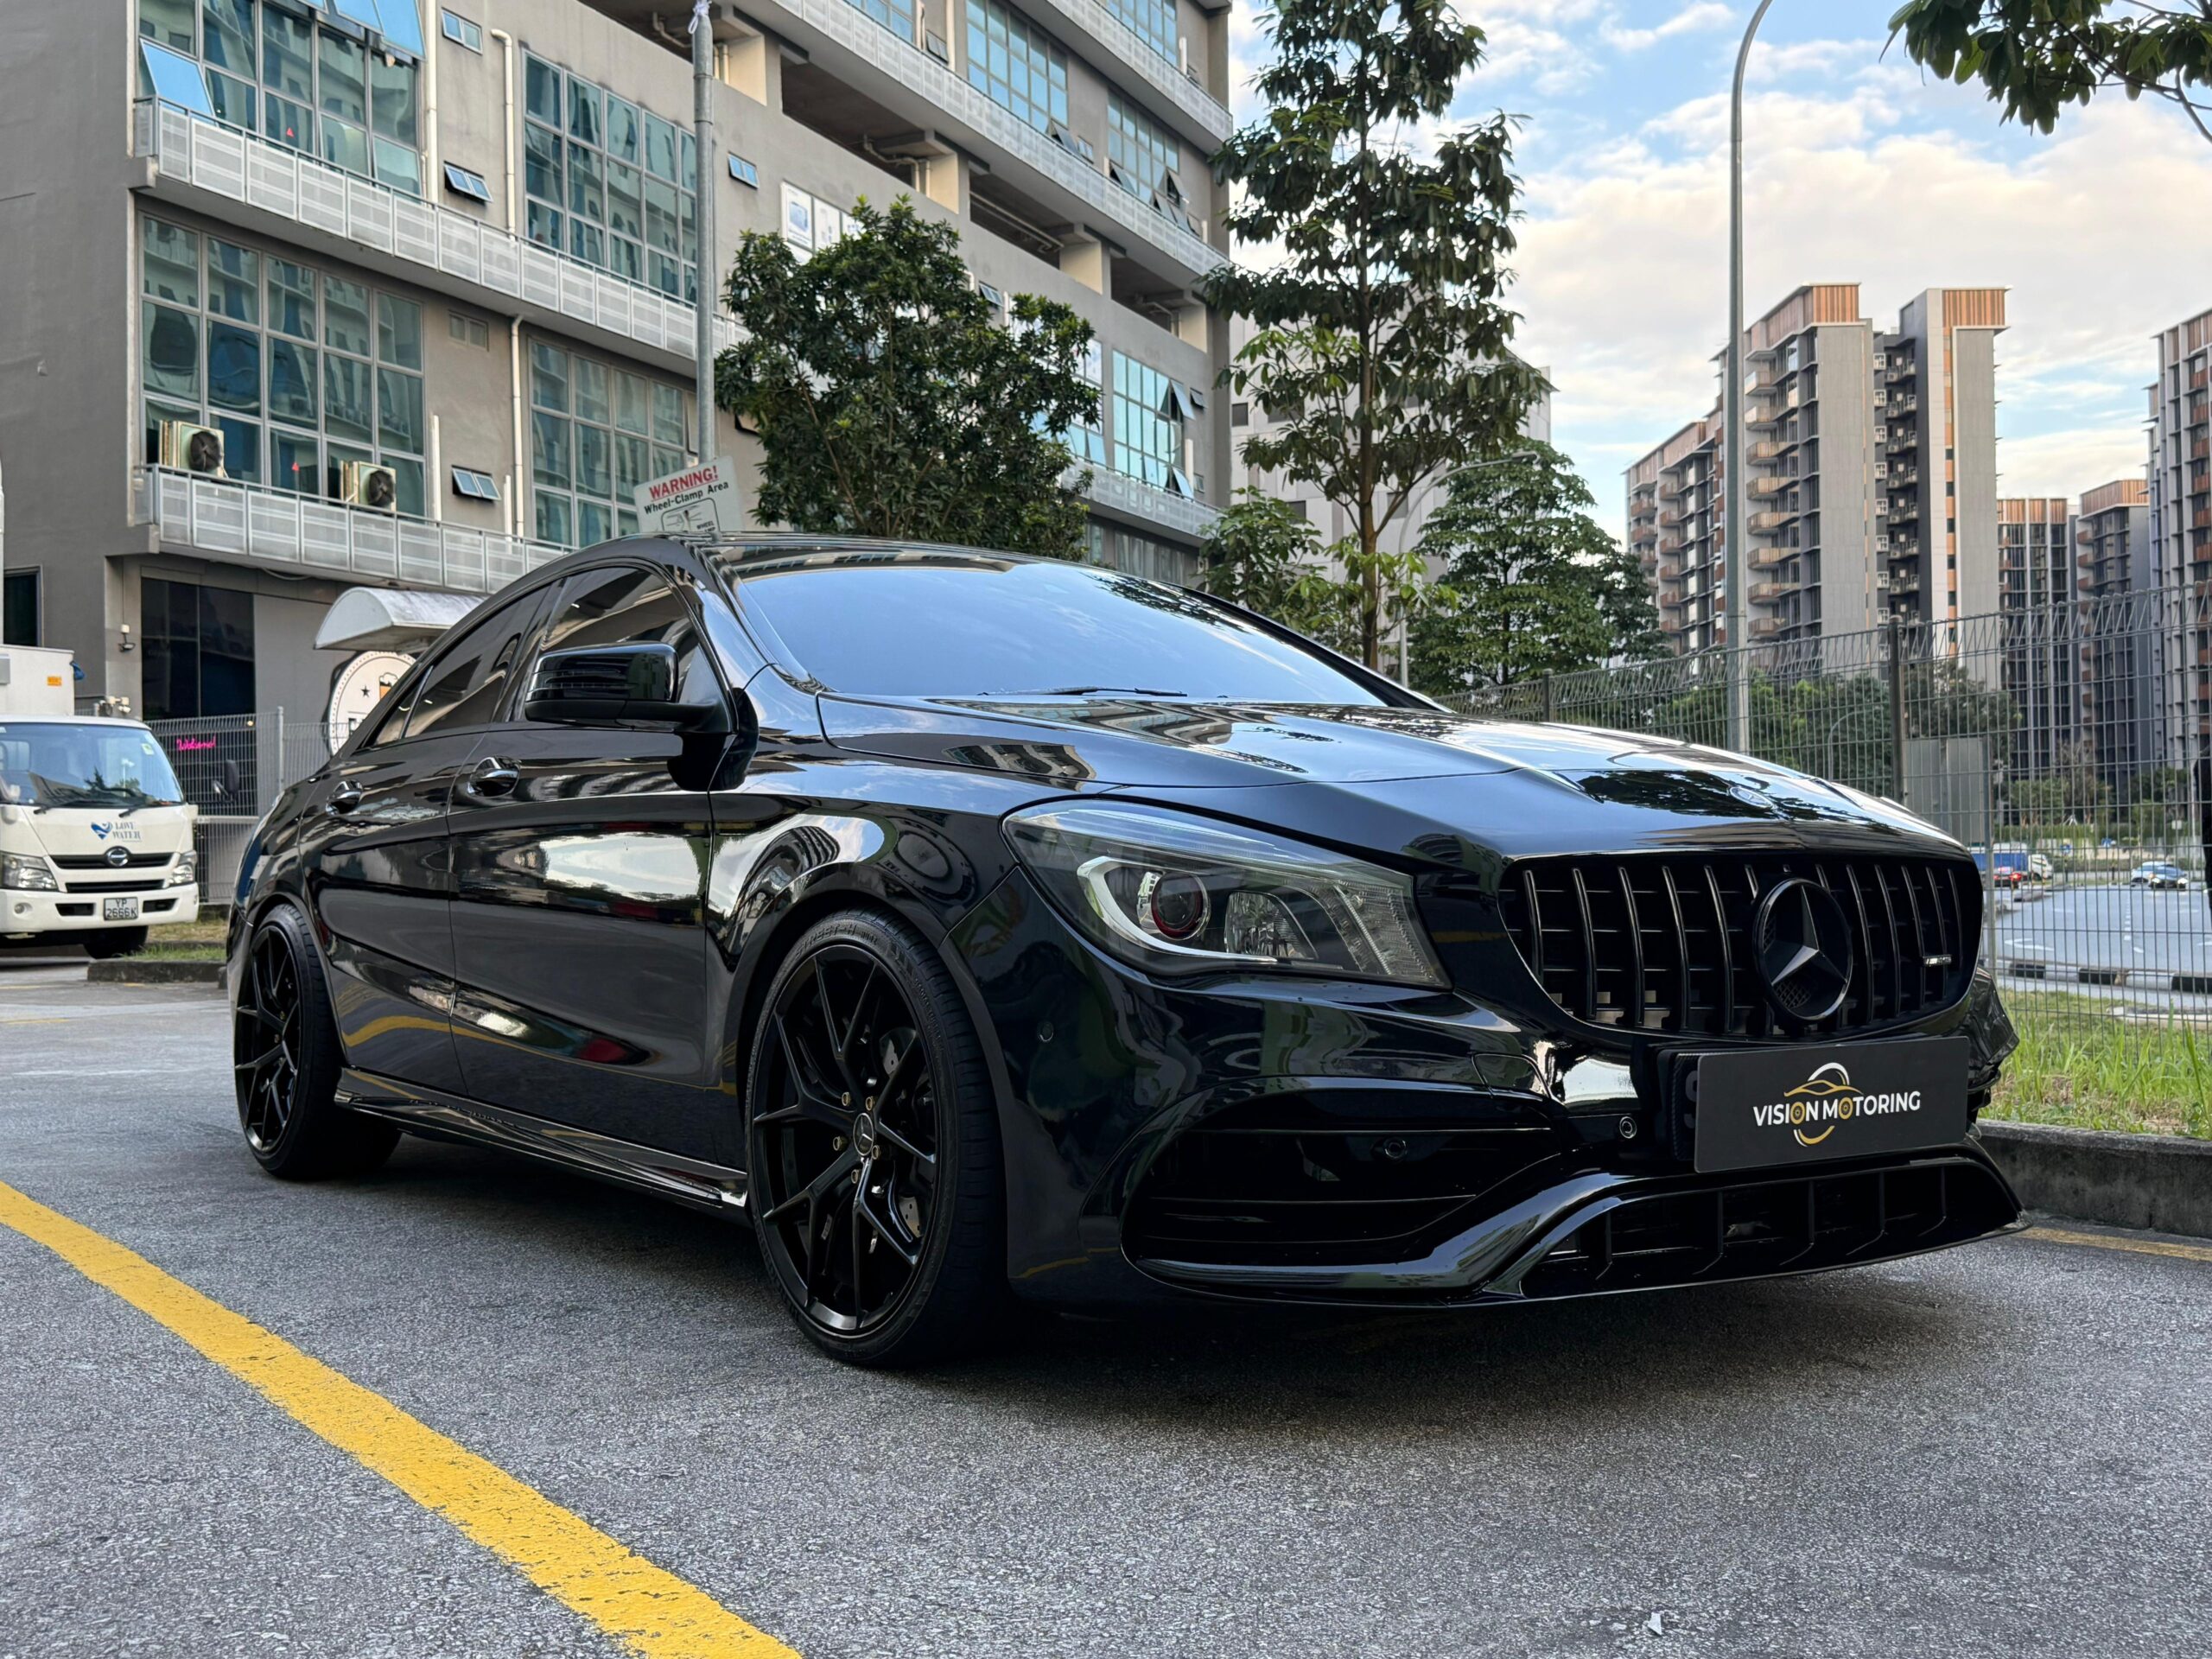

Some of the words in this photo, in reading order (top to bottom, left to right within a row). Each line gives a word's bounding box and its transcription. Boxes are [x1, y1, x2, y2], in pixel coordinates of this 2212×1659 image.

[644, 488, 703, 515] Wheel-Clamp
[707, 481, 729, 495] Area
[650, 465, 719, 499] WARNING!
[112, 830, 142, 840] WATER
[115, 899, 127, 907] YP
[1753, 1100, 1819, 1127] VISION
[1823, 1090, 1921, 1120] MOTORING
